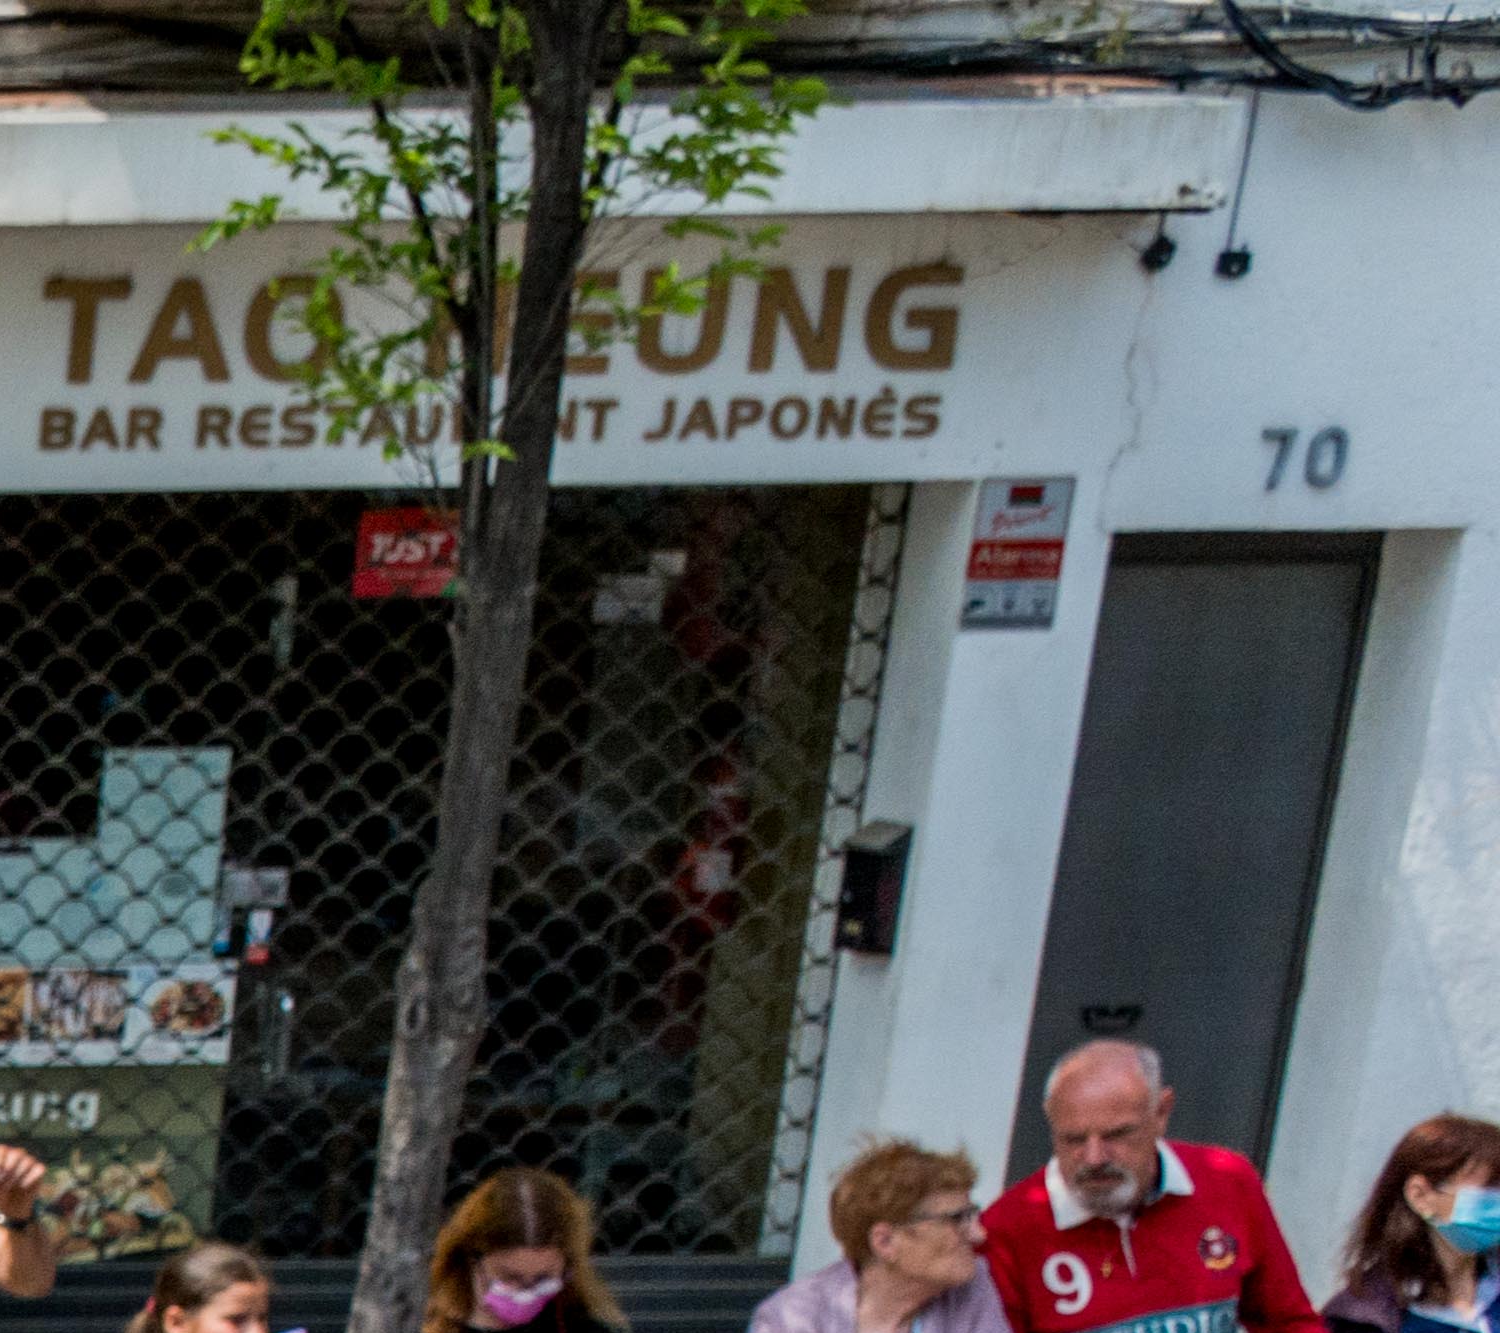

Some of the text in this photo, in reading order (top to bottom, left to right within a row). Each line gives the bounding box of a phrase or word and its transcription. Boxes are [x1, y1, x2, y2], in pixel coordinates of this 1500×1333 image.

[39, 406, 162, 451] BAR
[196, 396, 618, 448] RESTAUNT
[1261, 425, 1350, 491] 70
[1042, 1251, 1093, 1316] 9
